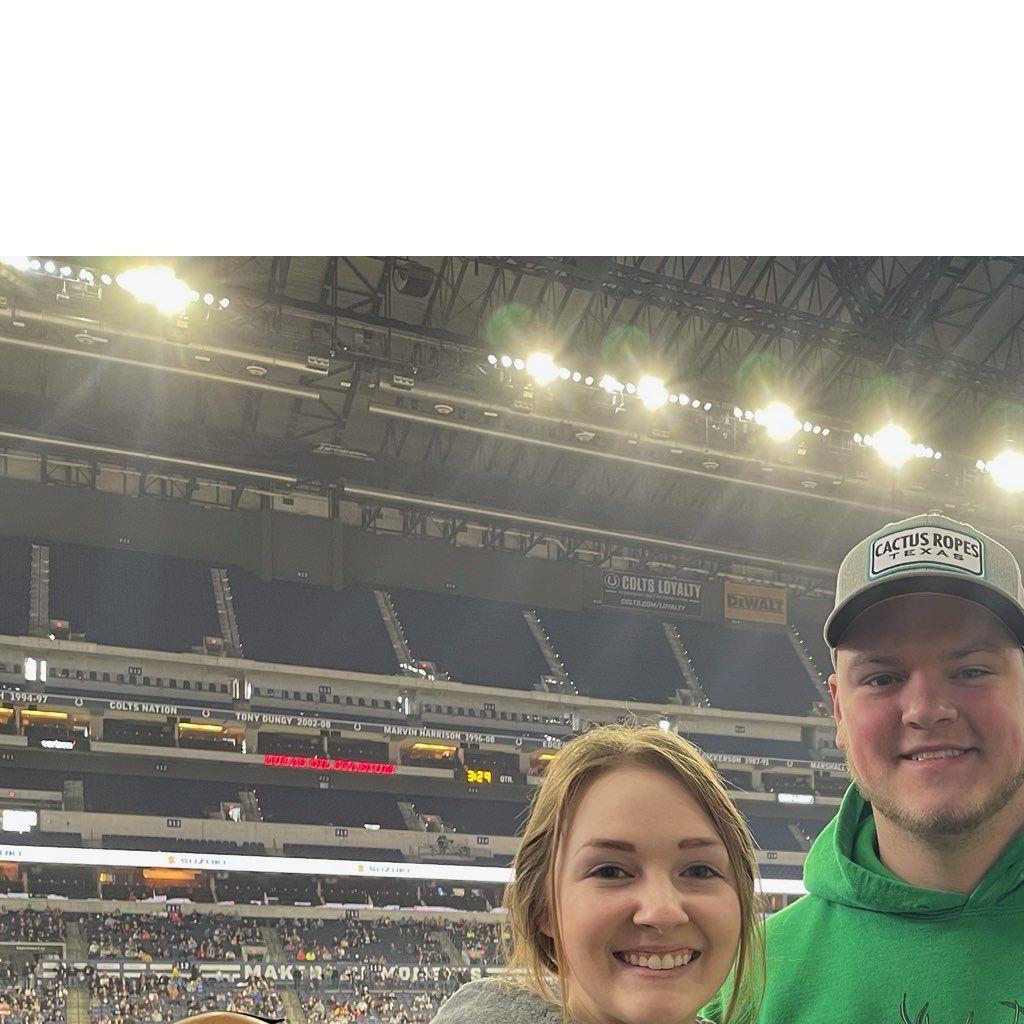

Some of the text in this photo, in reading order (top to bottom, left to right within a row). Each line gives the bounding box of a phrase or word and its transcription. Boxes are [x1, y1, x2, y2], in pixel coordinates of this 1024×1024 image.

[875, 532, 979, 558] CACTUS ROPES
[889, 548, 964, 560] TEXAS
[621, 575, 656, 592] COLTS
[658, 578, 702, 598] LOYALTY
[109, 701, 178, 715] COLTS NATION
[235, 712, 331, 729] TONY DUNGY 2002-08
[383, 725, 418, 736] MARVIN
[419, 727, 461, 741] HARRISON
